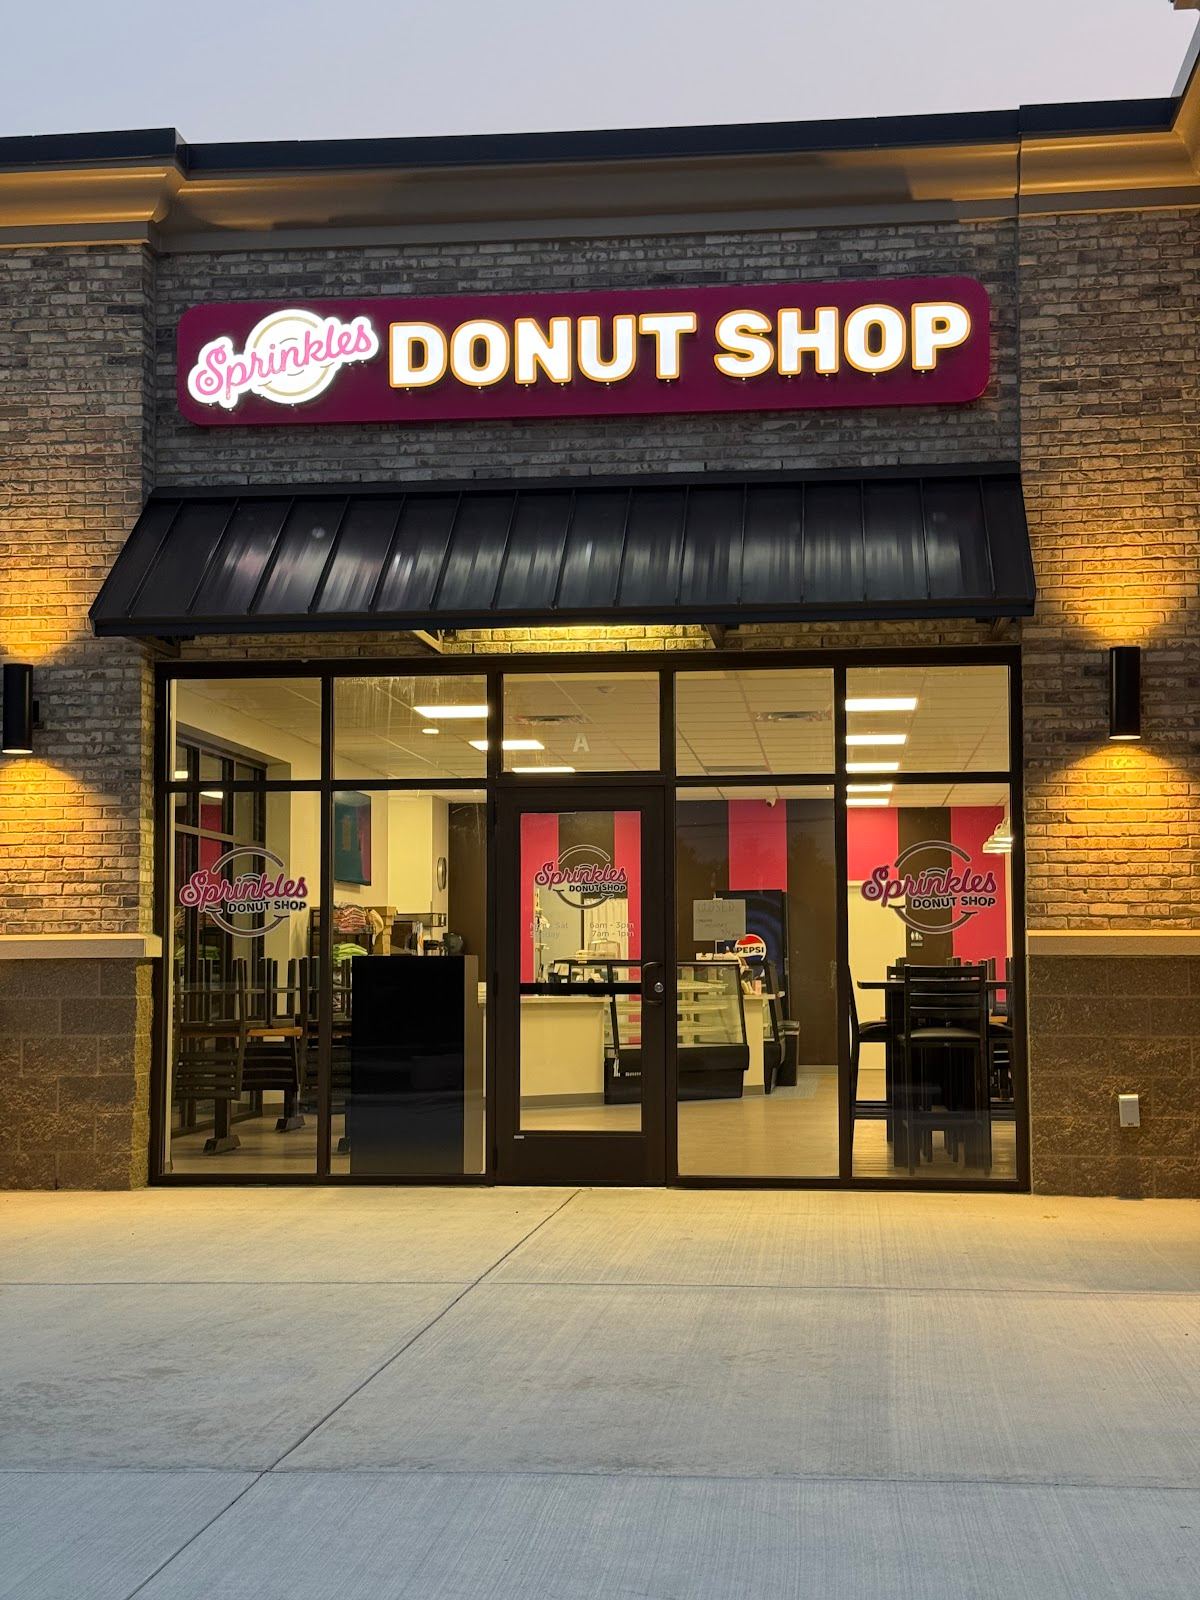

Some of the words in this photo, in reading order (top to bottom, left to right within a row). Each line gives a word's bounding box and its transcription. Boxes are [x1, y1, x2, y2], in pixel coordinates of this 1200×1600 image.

[195, 324, 372, 400] Sprinkles
[389, 312, 697, 388] DONUT
[713, 302, 971, 378] SHOP
[573, 732, 590, 752] A
[535, 862, 628, 890] Sprinkles
[180, 870, 308, 912] Sprinkles
[569, 884, 600, 893] DONUT
[601, 883, 626, 892] SHOP
[861, 865, 997, 907] Sprinkles
[228, 901, 270, 914] DONUT
[274, 900, 307, 911] SHOP
[912, 897, 957, 909] DONUT
[961, 895, 996, 907] SHOP
[590, 921, 608, 929] 6am
[616, 921, 635, 931] 3pm
[617, 930, 635, 939] 1pm
[736, 945, 764, 954] PEPSI
